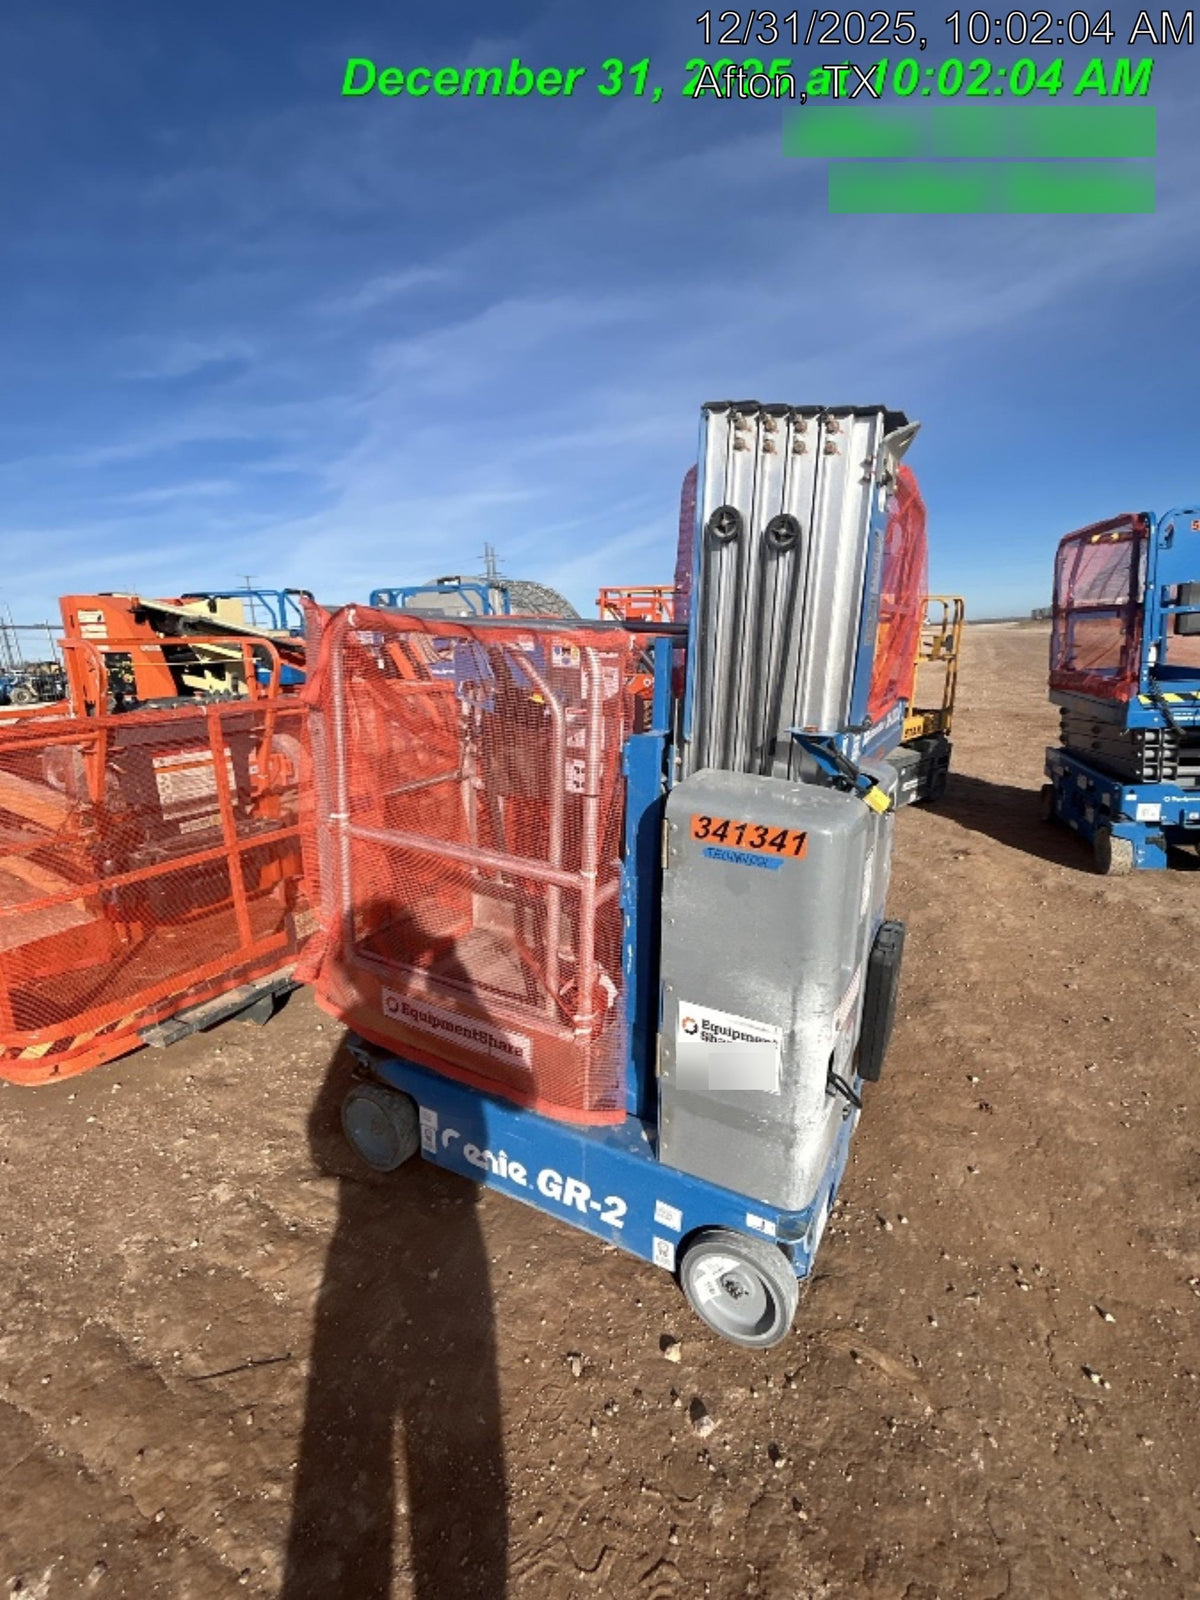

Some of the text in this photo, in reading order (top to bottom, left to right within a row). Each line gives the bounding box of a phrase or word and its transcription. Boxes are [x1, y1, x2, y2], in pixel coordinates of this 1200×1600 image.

[694, 815, 808, 856] 341341
[401, 1001, 524, 1057] EquipmentShare
[536, 1168, 628, 1229] GR-2
